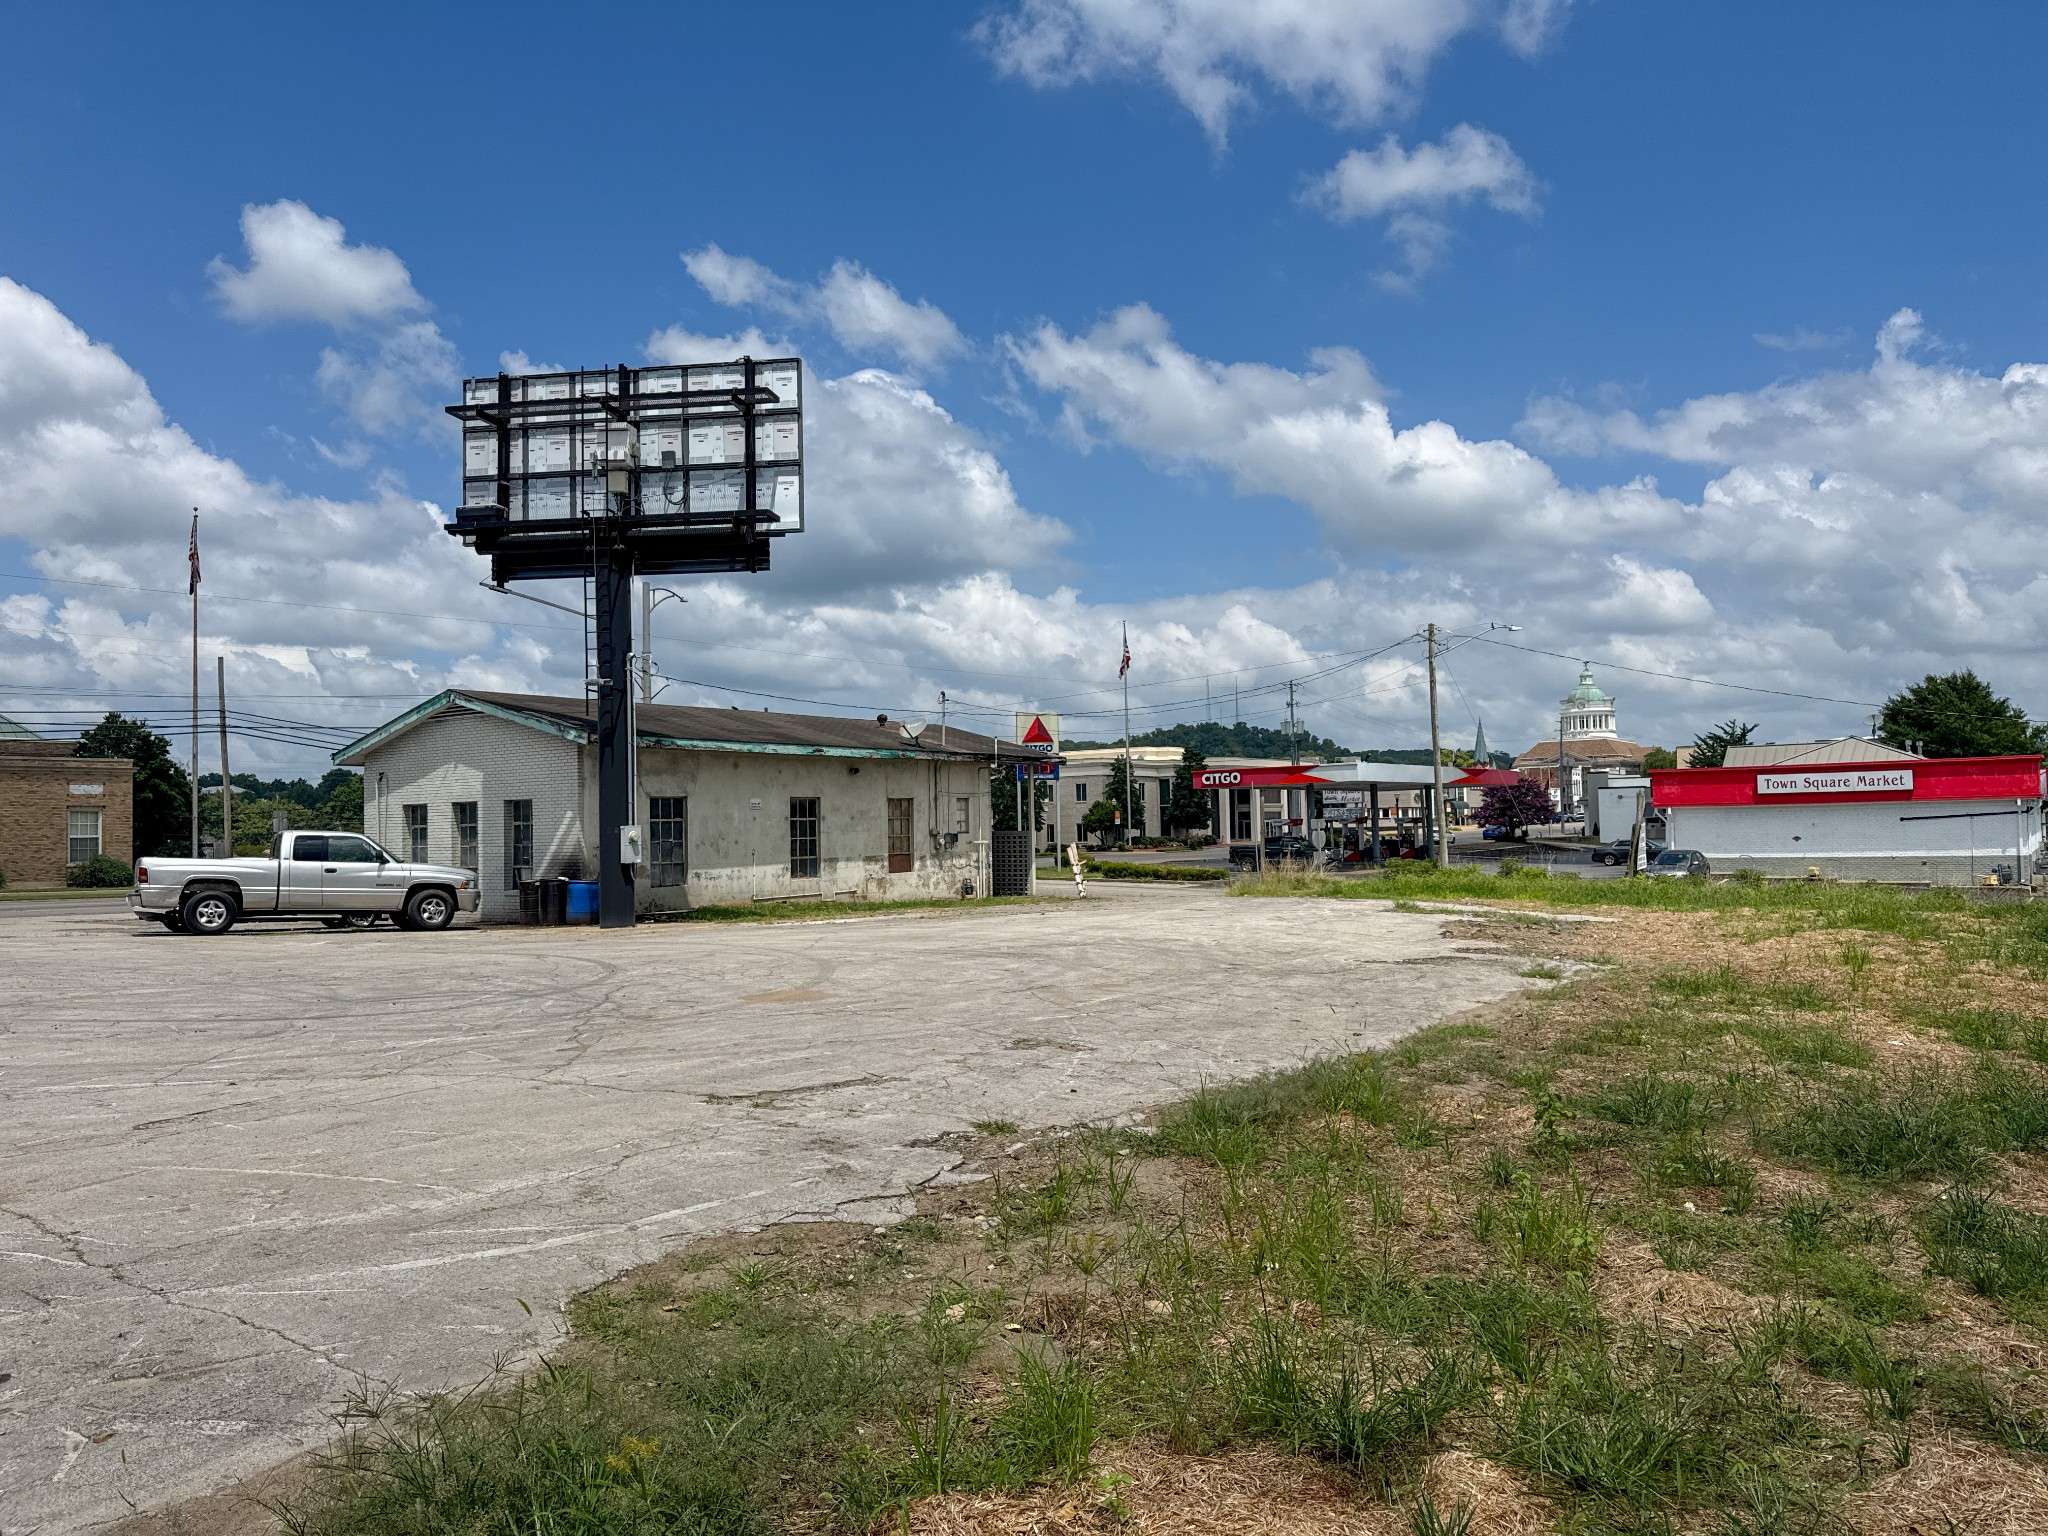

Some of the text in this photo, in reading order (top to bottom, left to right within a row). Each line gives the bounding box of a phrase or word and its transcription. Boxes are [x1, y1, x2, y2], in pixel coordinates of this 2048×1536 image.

[1201, 772, 1241, 785] CITGO
[1764, 774, 1905, 790] Town Square Market
